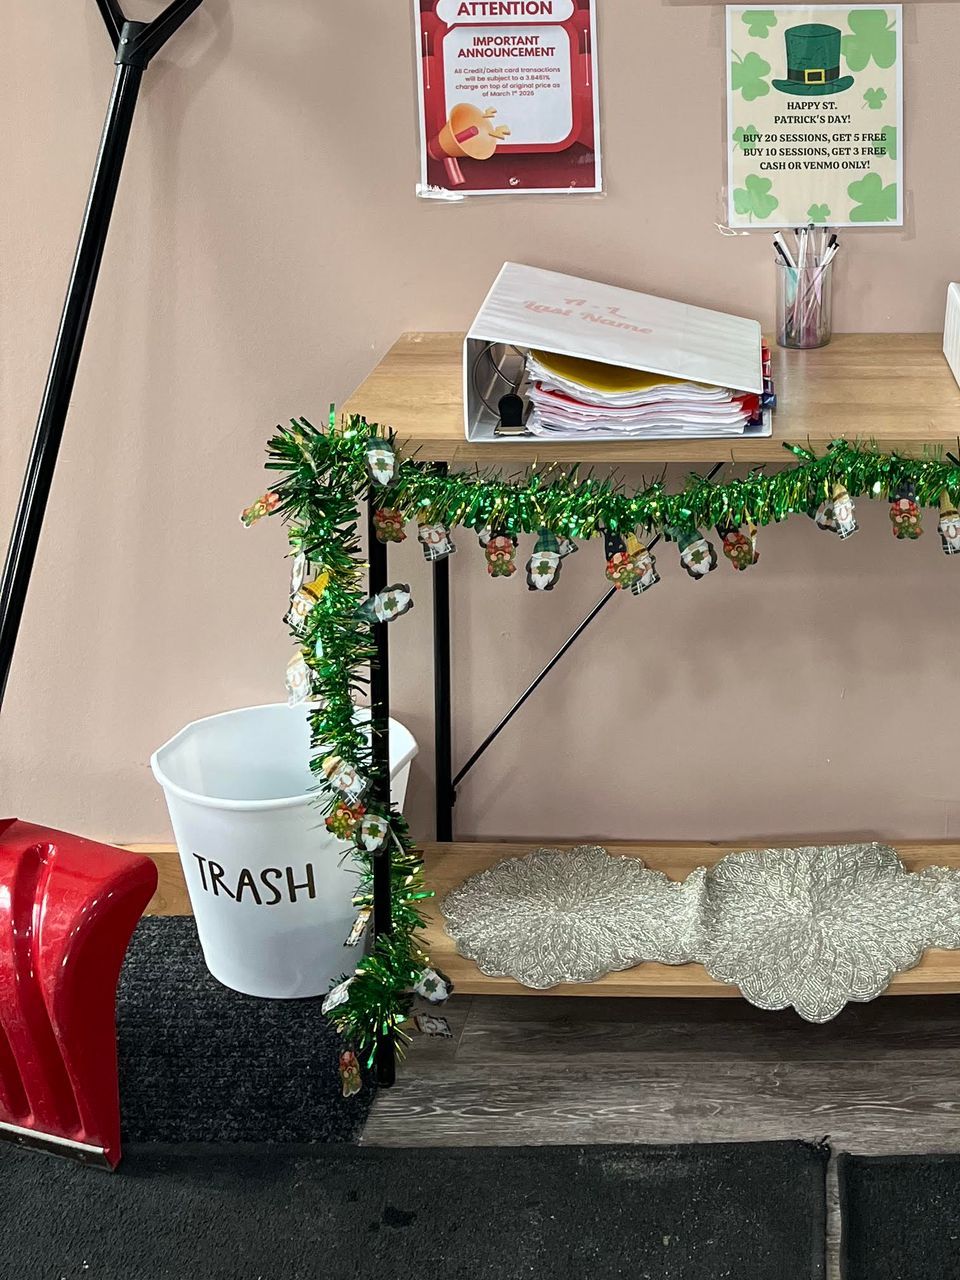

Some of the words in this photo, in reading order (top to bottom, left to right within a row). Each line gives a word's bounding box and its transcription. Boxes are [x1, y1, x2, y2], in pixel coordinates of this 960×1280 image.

[457, 1, 552, 16] ATTENTION
[473, 36, 539, 46] IMPORTANT
[458, 47, 556, 58] ANNOUNCEMENT
[787, 102, 820, 110] HAPPY
[822, 101, 837, 110] ST.
[774, 115, 826, 124] PATRICK'S
[828, 115, 851, 123] DAY!
[743, 134, 763, 142] BUY
[764, 134, 777, 142] 20
[780, 134, 830, 144] SESSIONS,
[832, 134, 851, 142] GET
[854, 134, 859, 142] 5
[862, 134, 887, 142] FREE
[743, 148, 763, 156] BUY
[765, 148, 777, 156] 10
[779, 148, 830, 157] SESSIONS,
[832, 147, 851, 156] GET
[853, 147, 859, 155] 3
[862, 147, 887, 155] FREE
[760, 161, 785, 170] CASH
[788, 161, 801, 170] OR
[803, 161, 840, 170] VENMO
[842, 160, 870, 169] ONLY!
[524, 300, 573, 316] Last
[580, 312, 653, 334] Name
[193, 853, 316, 905] TRASH
